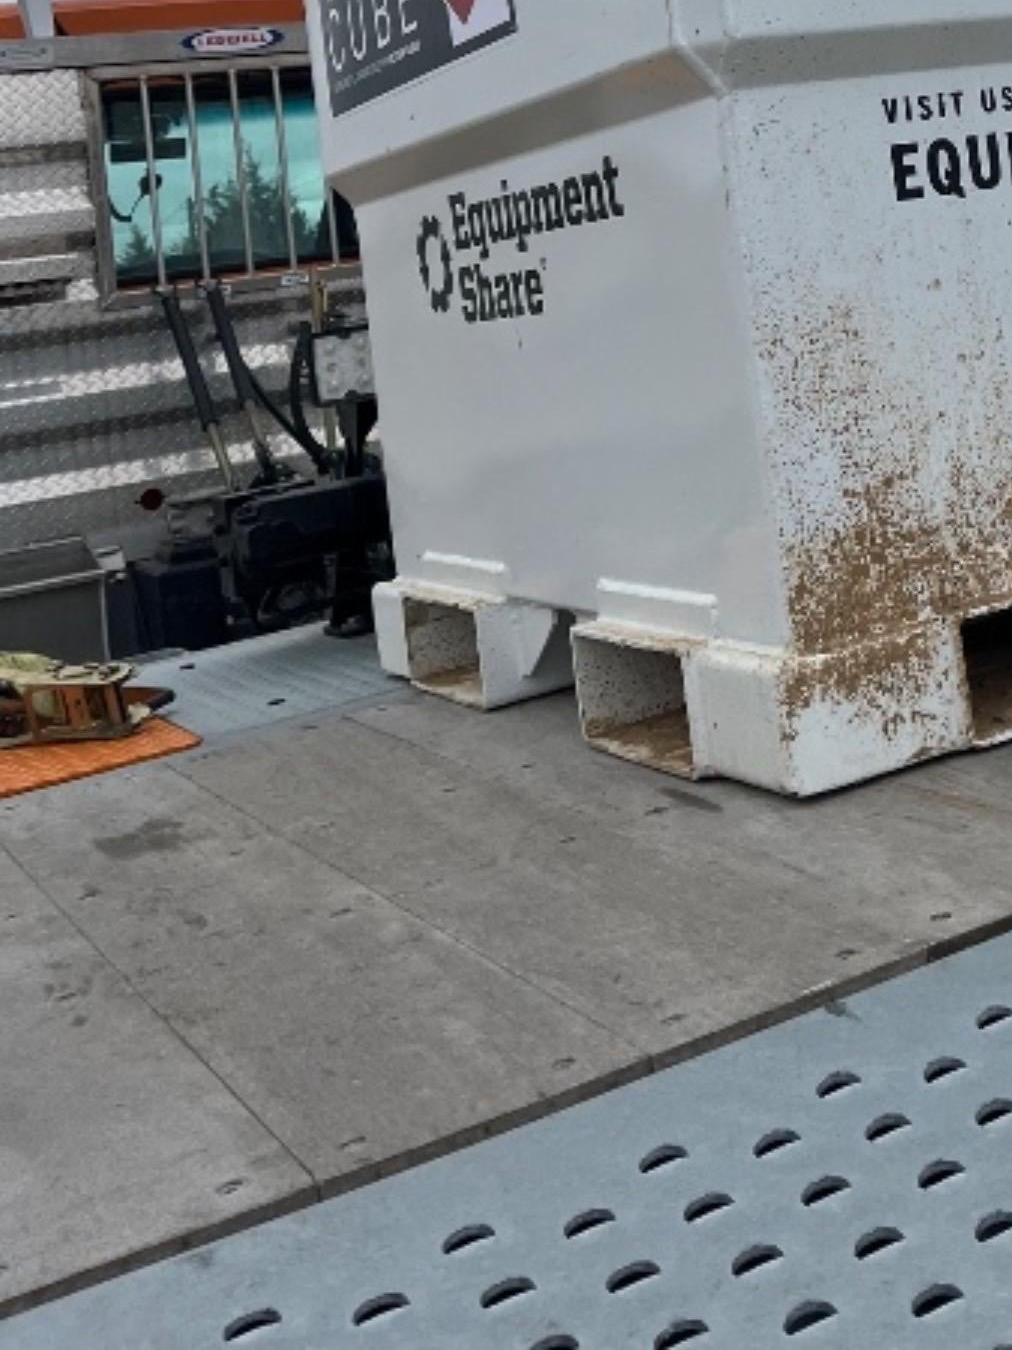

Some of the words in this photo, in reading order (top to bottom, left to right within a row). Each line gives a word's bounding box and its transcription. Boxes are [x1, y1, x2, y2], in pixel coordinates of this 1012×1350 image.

[882, 91, 965, 124] VISIT
[448, 155, 625, 259] Equipment
[458, 263, 544, 324] Share
